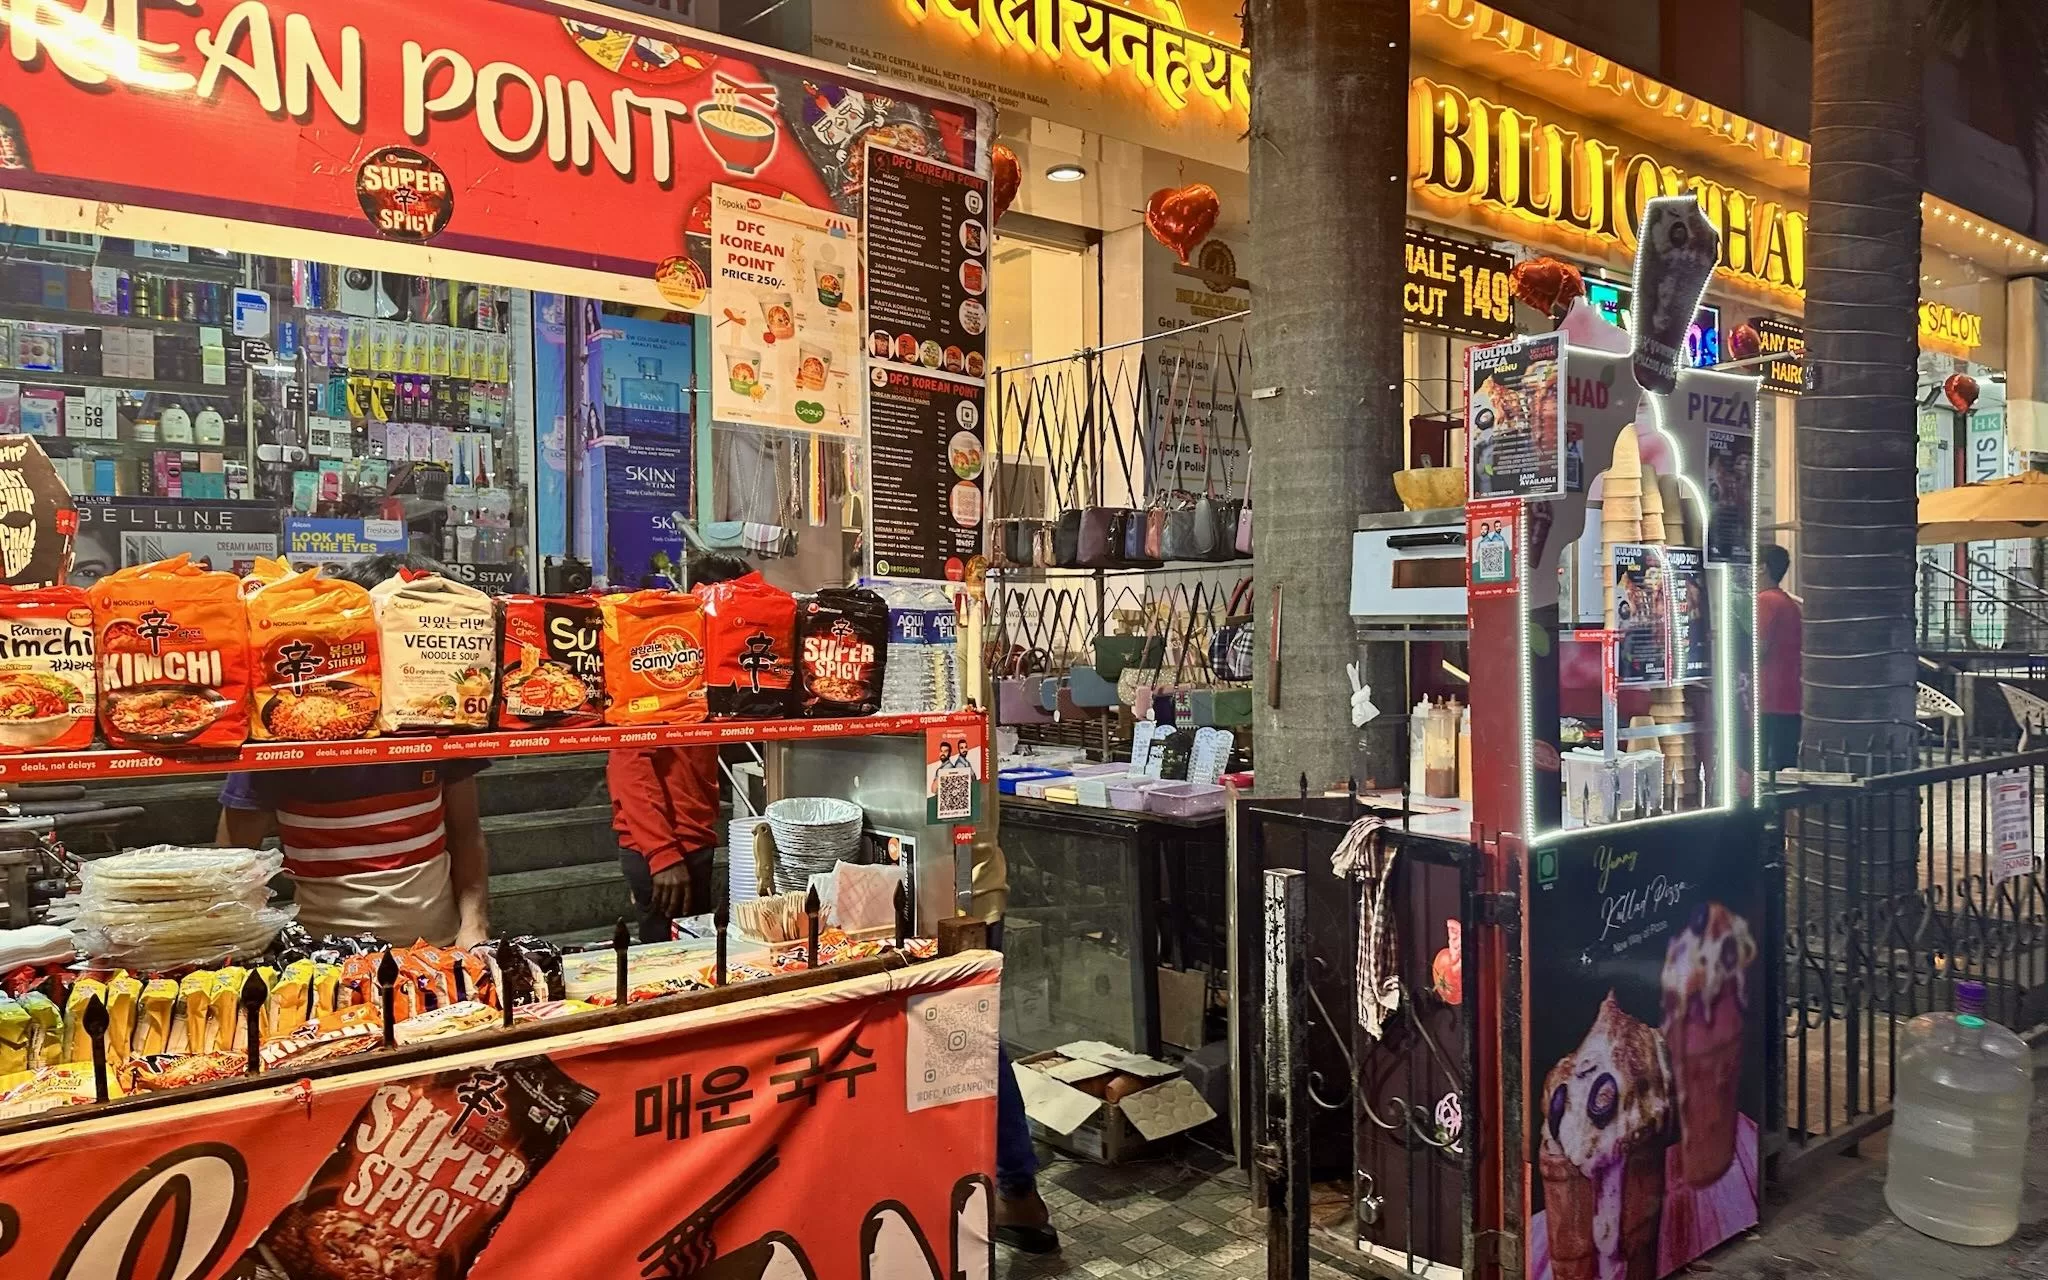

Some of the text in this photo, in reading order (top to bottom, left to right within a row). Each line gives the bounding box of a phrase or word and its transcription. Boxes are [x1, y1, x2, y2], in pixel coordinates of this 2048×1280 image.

[889, 56, 921, 72] CENTRAL
[943, 70, 960, 82] NEXT
[961, 75, 971, 84] TO
[402, 41, 689, 182] POINT
[364, 165, 446, 192] SUPER
[892, 154, 913, 170] DFC
[915, 160, 955, 183] KOREAN
[380, 208, 437, 233] SPICY
[736, 219, 766, 237] DFC
[720, 233, 785, 258] KOREAN
[727, 252, 775, 272] POINT
[721, 267, 786, 289] PRICE 250/-
[1404, 264, 1509, 322] CUT 149
[1158, 316, 1177, 328] Gel
[1927, 300, 1982, 347] SALON
[285, 322, 293, 349] PUSH
[1158, 355, 1178, 366] Gel
[1474, 343, 1522, 362] KULHAD
[1474, 356, 1507, 372] PIZZA
[1493, 363, 1518, 374] MENU
[889, 372, 909, 385] DFC
[912, 377, 951, 393] KOREAN
[953, 385, 979, 399] POINT
[1687, 391, 1751, 427] PIZZA
[1974, 415, 2000, 430] HK
[1709, 431, 1735, 443] KULHAD
[1709, 440, 1728, 450] PIZZA
[625, 465, 677, 483] SKINN
[1519, 476, 1557, 487] AVAILABLE
[652, 481, 676, 490] TITAN
[291, 532, 356, 543] LOOK ME
[366, 526, 401, 536] Freshlook
[216, 541, 274, 552] CREAMY MATTES
[291, 542, 377, 553] IN THE EYES
[5, 547, 33, 579] LENGE
[1616, 557, 1636, 565] PIZZA
[478, 571, 513, 583] STAY
[113, 599, 155, 607] NONGSHIM
[11, 624, 62, 637] Ramen
[137, 608, 178, 656] 辛
[831, 618, 854, 648] 辛
[404, 634, 494, 651] VEGETASTY
[804, 637, 875, 663] SUPER
[327, 655, 367, 670] STIR FRY
[420, 650, 480, 661] NOODLE SOUP
[631, 648, 704, 672] samyang
[738, 631, 779, 694] 辛
[102, 650, 223, 692] KIMCHI
[276, 639, 324, 697] 辛
[403, 666, 415, 675] 60
[815, 658, 861, 681] SPICY
[464, 697, 488, 714] 60
[631, 700, 641, 711] 5
[21, 762, 49, 772] deals,
[50, 761, 66, 770] not
[67, 760, 96, 771] delays
[109, 758, 163, 769] zomato
[255, 749, 304, 761] zomato
[315, 748, 339, 758] deals,
[339, 748, 352, 757] not
[353, 746, 377, 757] delays
[388, 743, 433, 755] zomato
[443, 742, 465, 751] deals,
[466, 742, 479, 750] not
[480, 740, 499, 750] delays
[509, 736, 550, 748] zomato
[559, 736, 578, 745] deals,
[591, 735, 611, 745] delays
[619, 731, 657, 742] zomato
[634, 1036, 877, 1141] 매운 국수
[450, 1072, 508, 1137] 辛
[356, 1085, 527, 1207] SUPER
[343, 1153, 473, 1249] SPICY
